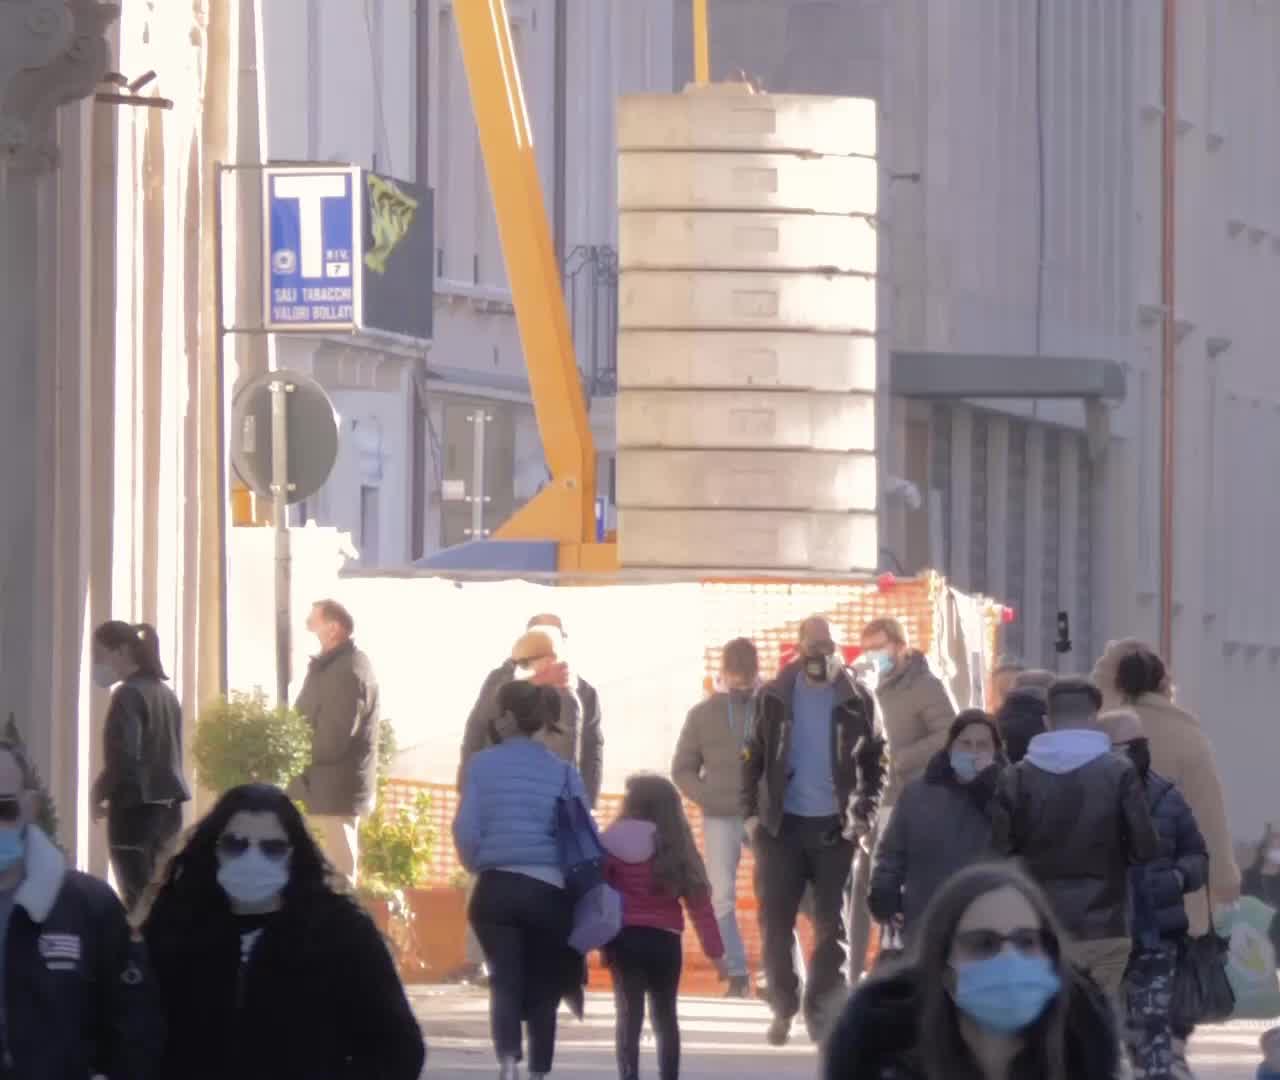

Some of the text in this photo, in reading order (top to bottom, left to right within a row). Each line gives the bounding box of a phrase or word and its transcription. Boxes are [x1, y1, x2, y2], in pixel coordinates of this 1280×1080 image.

[274, 175, 346, 278] T
[274, 287, 351, 302] SALI TABACCH
[273, 304, 353, 320] VALORI BOLLATI
